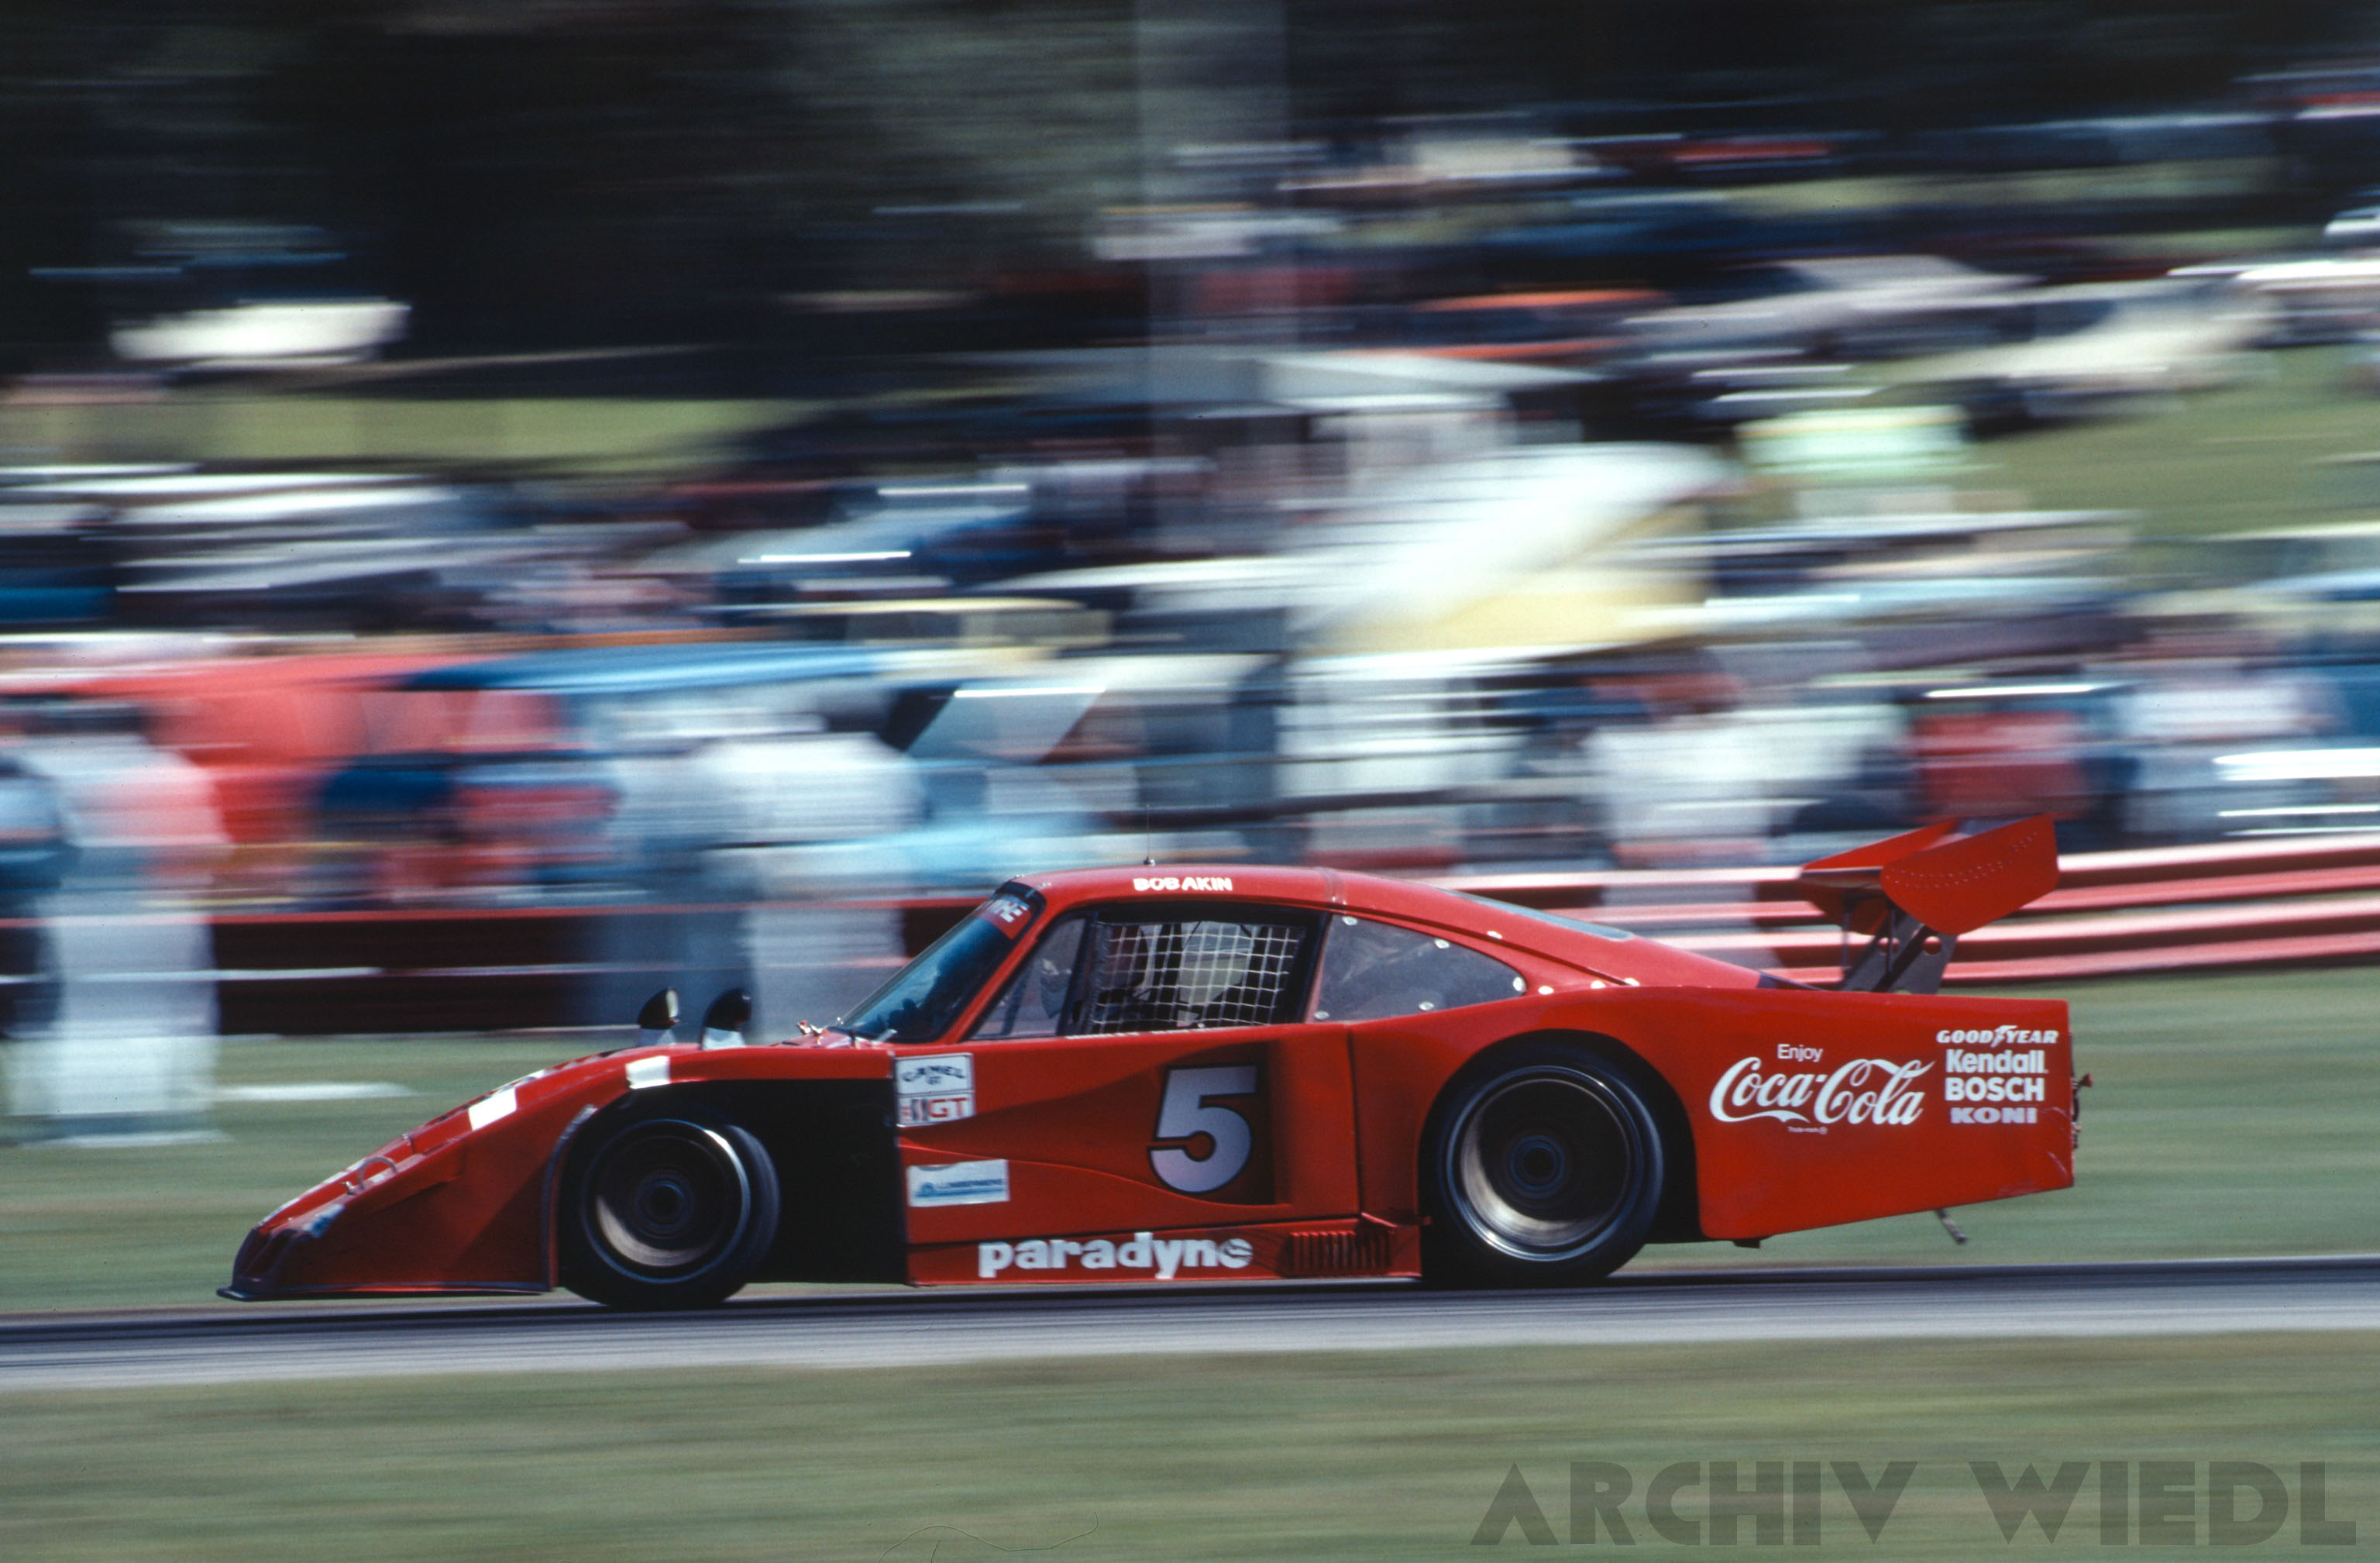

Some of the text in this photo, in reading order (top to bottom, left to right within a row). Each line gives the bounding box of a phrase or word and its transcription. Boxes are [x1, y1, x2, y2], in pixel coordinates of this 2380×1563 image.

[1133, 876, 1233, 891] BOB AKIN
[1936, 1024, 2059, 1048] GOODYEAR
[1777, 1044, 1823, 1062] Enjoy
[1945, 1048, 2046, 1074] Kendall
[1709, 1056, 1935, 1125] Coca-Cola
[1945, 1076, 2045, 1102] BOSCH
[928, 1097, 968, 1118] GT
[1950, 1107, 2038, 1124] KONI
[1150, 1066, 1258, 1193] 5
[978, 1231, 1254, 1279] paradyne
